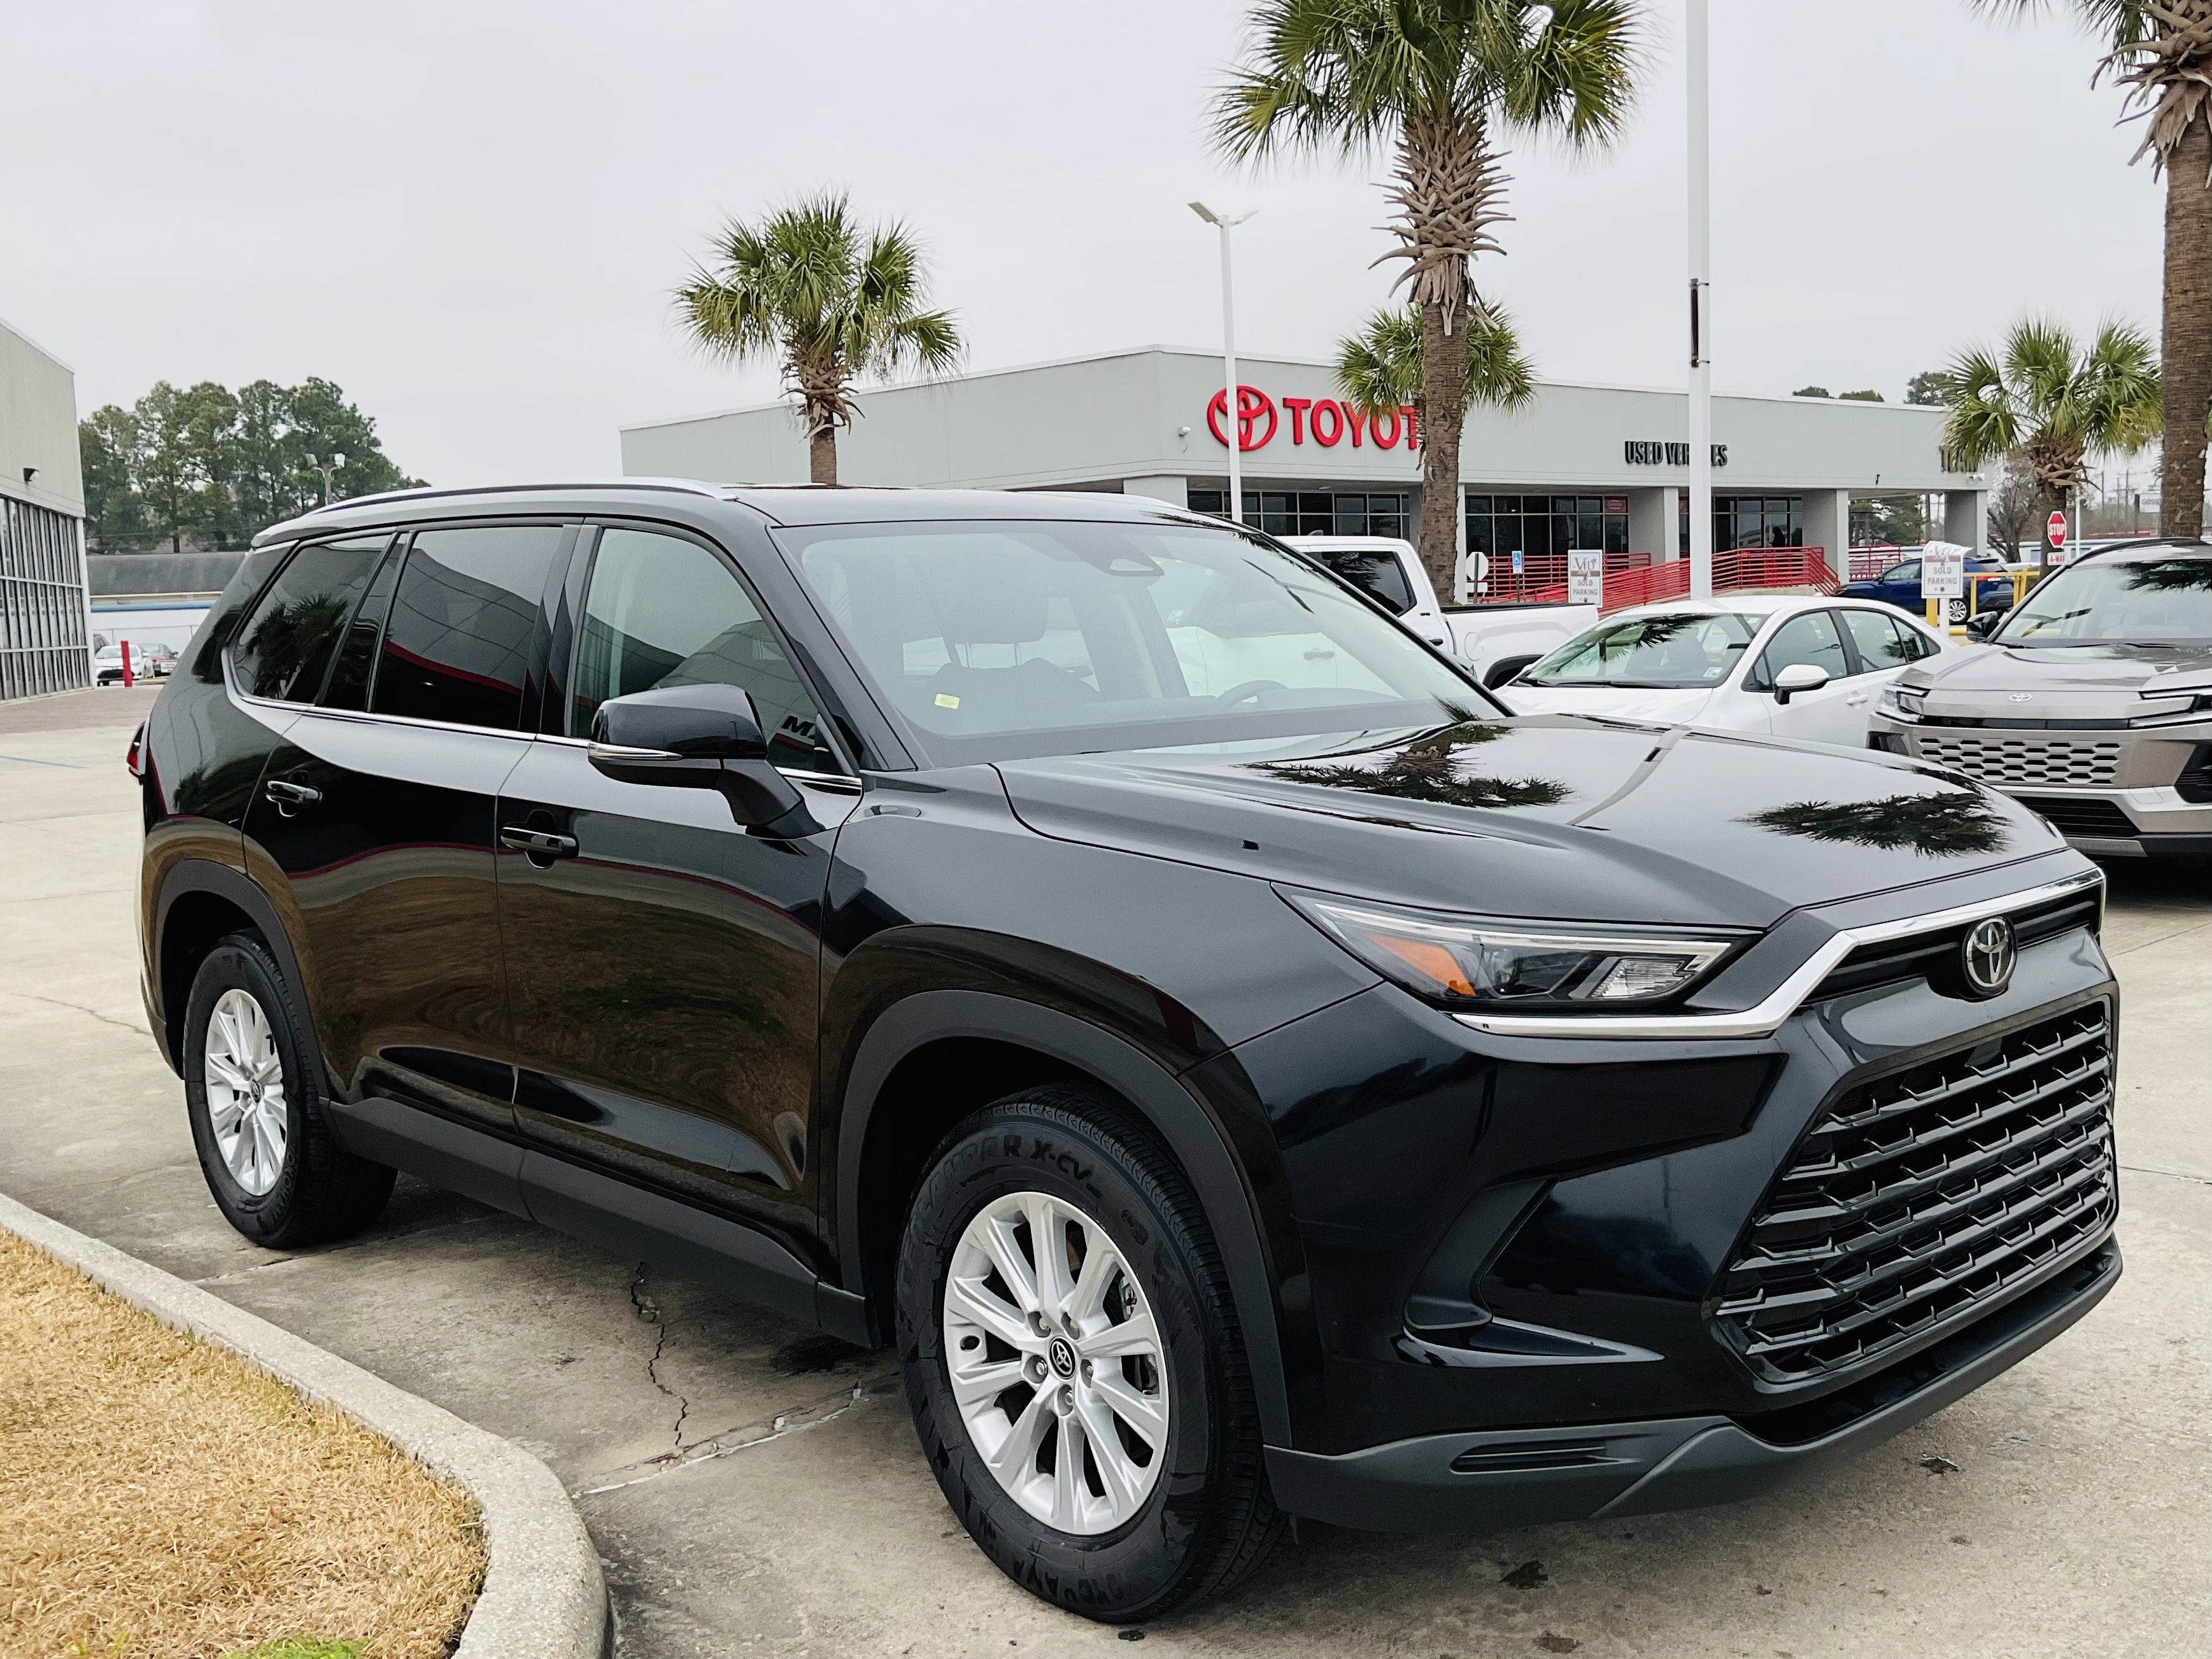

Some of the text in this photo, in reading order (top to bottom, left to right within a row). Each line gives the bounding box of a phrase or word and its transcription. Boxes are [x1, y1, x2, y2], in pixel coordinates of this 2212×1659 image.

[1282, 397, 1422, 450] TOYOT
[1624, 441, 1727, 467] USED VEHES
[2049, 523, 2066, 536] STOP
[2050, 554, 2066, 563] 4-WAY
